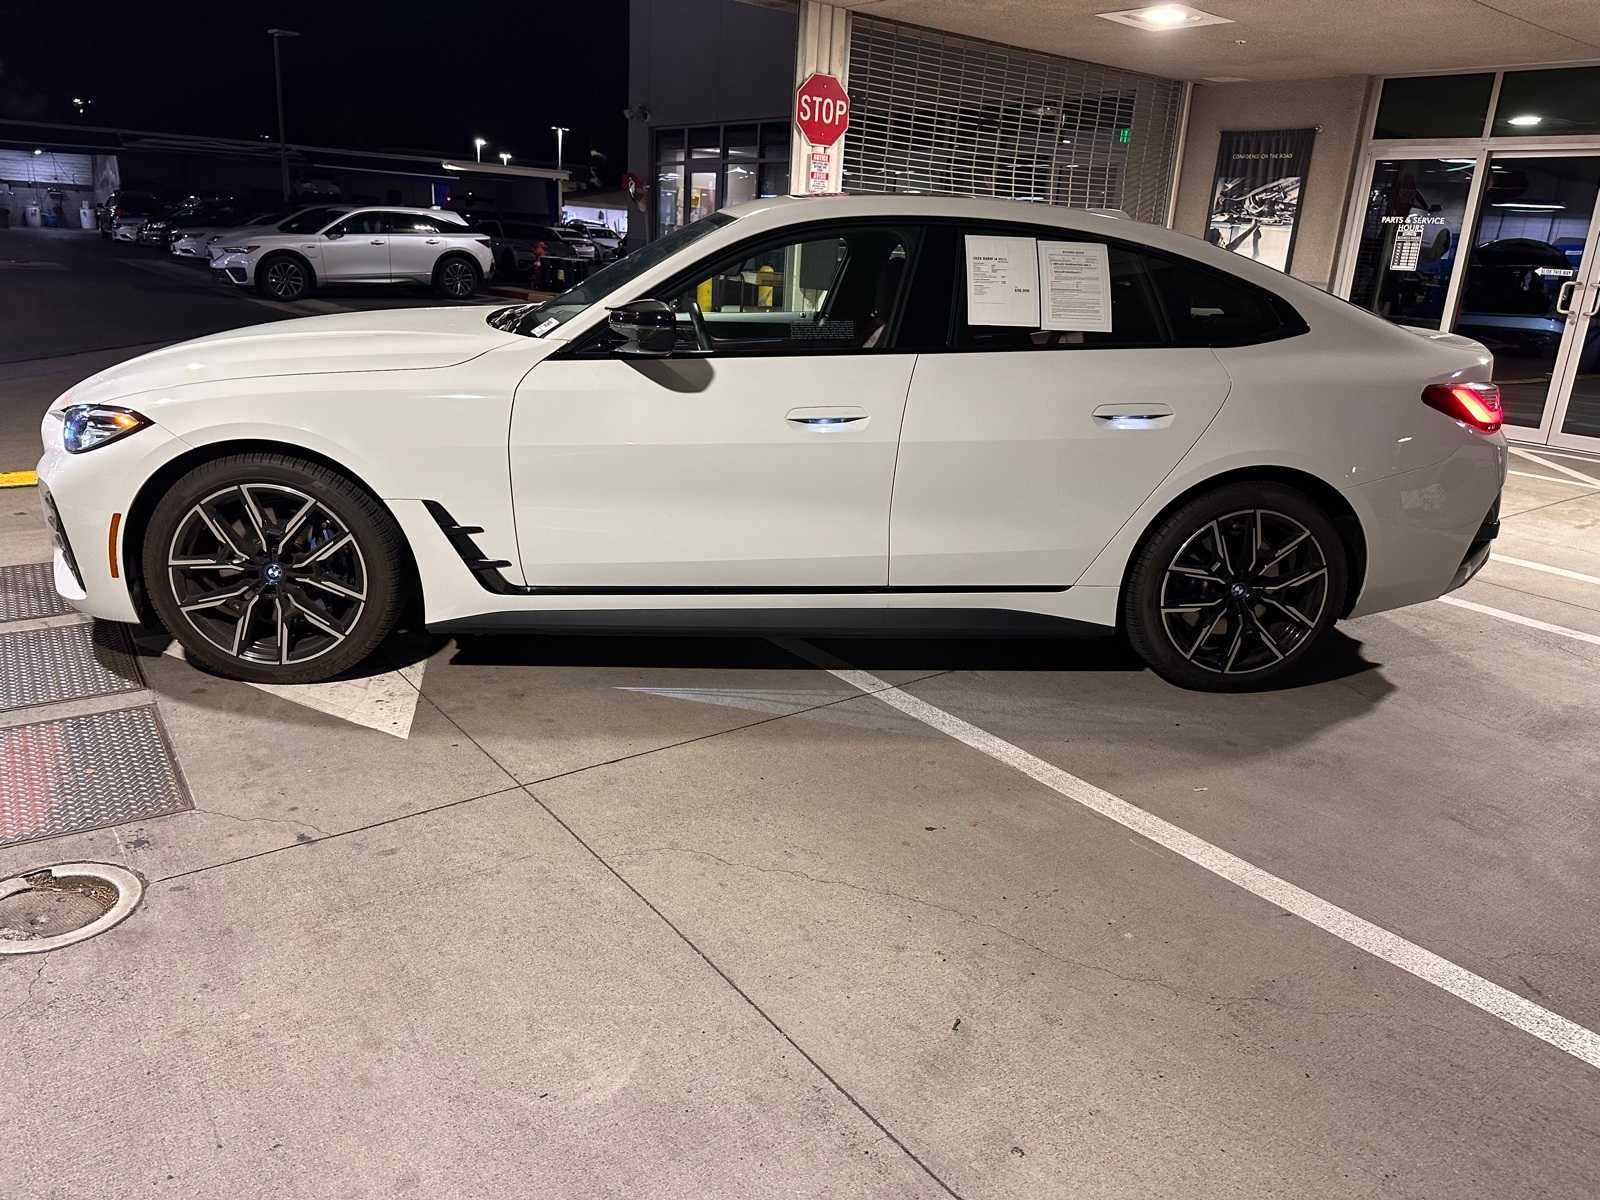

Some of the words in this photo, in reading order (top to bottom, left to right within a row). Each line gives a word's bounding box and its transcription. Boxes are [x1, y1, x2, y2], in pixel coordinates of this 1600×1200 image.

[800, 95, 847, 125] STOP
[1381, 216, 1404, 224] PARTS
[1412, 216, 1445, 225] SERVICE
[1397, 224, 1424, 232] HOURS
